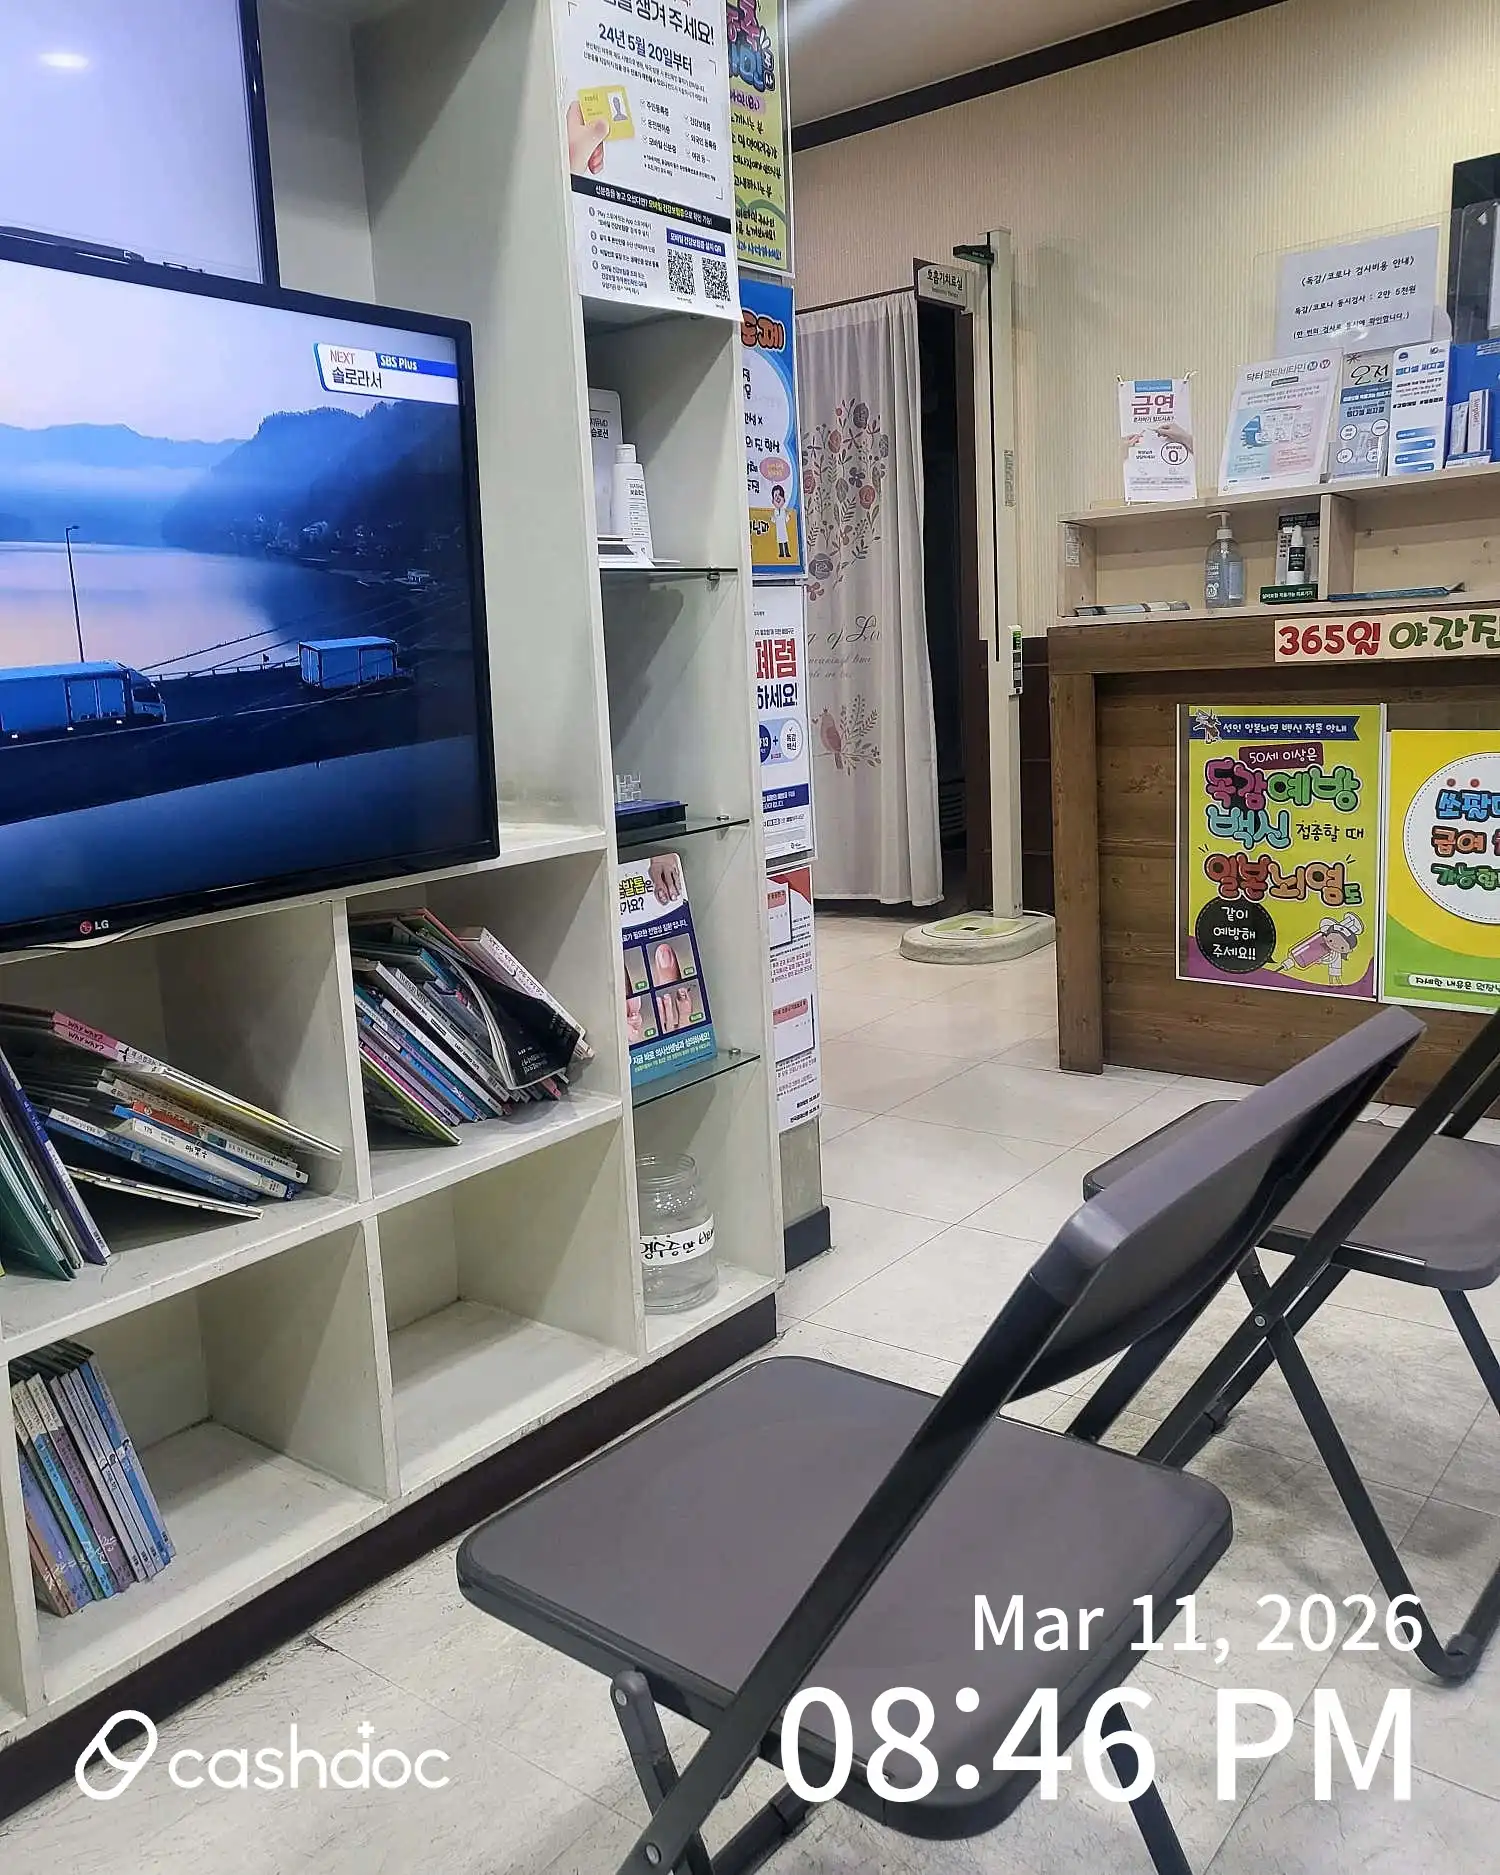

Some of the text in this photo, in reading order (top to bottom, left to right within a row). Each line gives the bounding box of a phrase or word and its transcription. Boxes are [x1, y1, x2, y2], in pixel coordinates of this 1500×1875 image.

[669, 7, 714, 46] 주세요!
[599, 23, 625, 49] 24년
[628, 34, 646, 58] 5월
[648, 43, 692, 76] 20일부터
[1356, 261, 1388, 276] 검사비용
[927, 269, 962, 291] 호흡기치료실
[1294, 301, 1333, 316] 독감/코로나
[1338, 295, 1366, 308] 동시검사
[1377, 290, 1391, 300] 2만
[1395, 284, 1416, 296] 5천원
[330, 349, 418, 371] NEXT SBS Plus
[332, 367, 382, 389] 솔로라서
[1131, 394, 1174, 415] 금연
[1278, 620, 1381, 655] 365일
[757, 682, 798, 710] 하세요!
[1244, 723, 1278, 734] 일본뇌염
[1281, 723, 1302, 734] 백신
[1305, 722, 1323, 734] 접종
[1325, 722, 1347, 734] 안내
[1249, 747, 1318, 764] 50세 이상은
[1206, 805, 1364, 850] 백신 접종할 때
[1431, 826, 1487, 858] 급여
[1204, 852, 1364, 907] 일본뇌염도
[1431, 862, 1500, 891] 가능합
[619, 898, 644, 917] 가요?
[1221, 906, 1249, 921] 같이
[94, 919, 109, 930] LG
[1213, 926, 1256, 941] 예방해
[1212, 944, 1256, 962] 주세요!!
[1416, 976, 1443, 987] 자세한
[1446, 980, 1472, 991] 내용은
